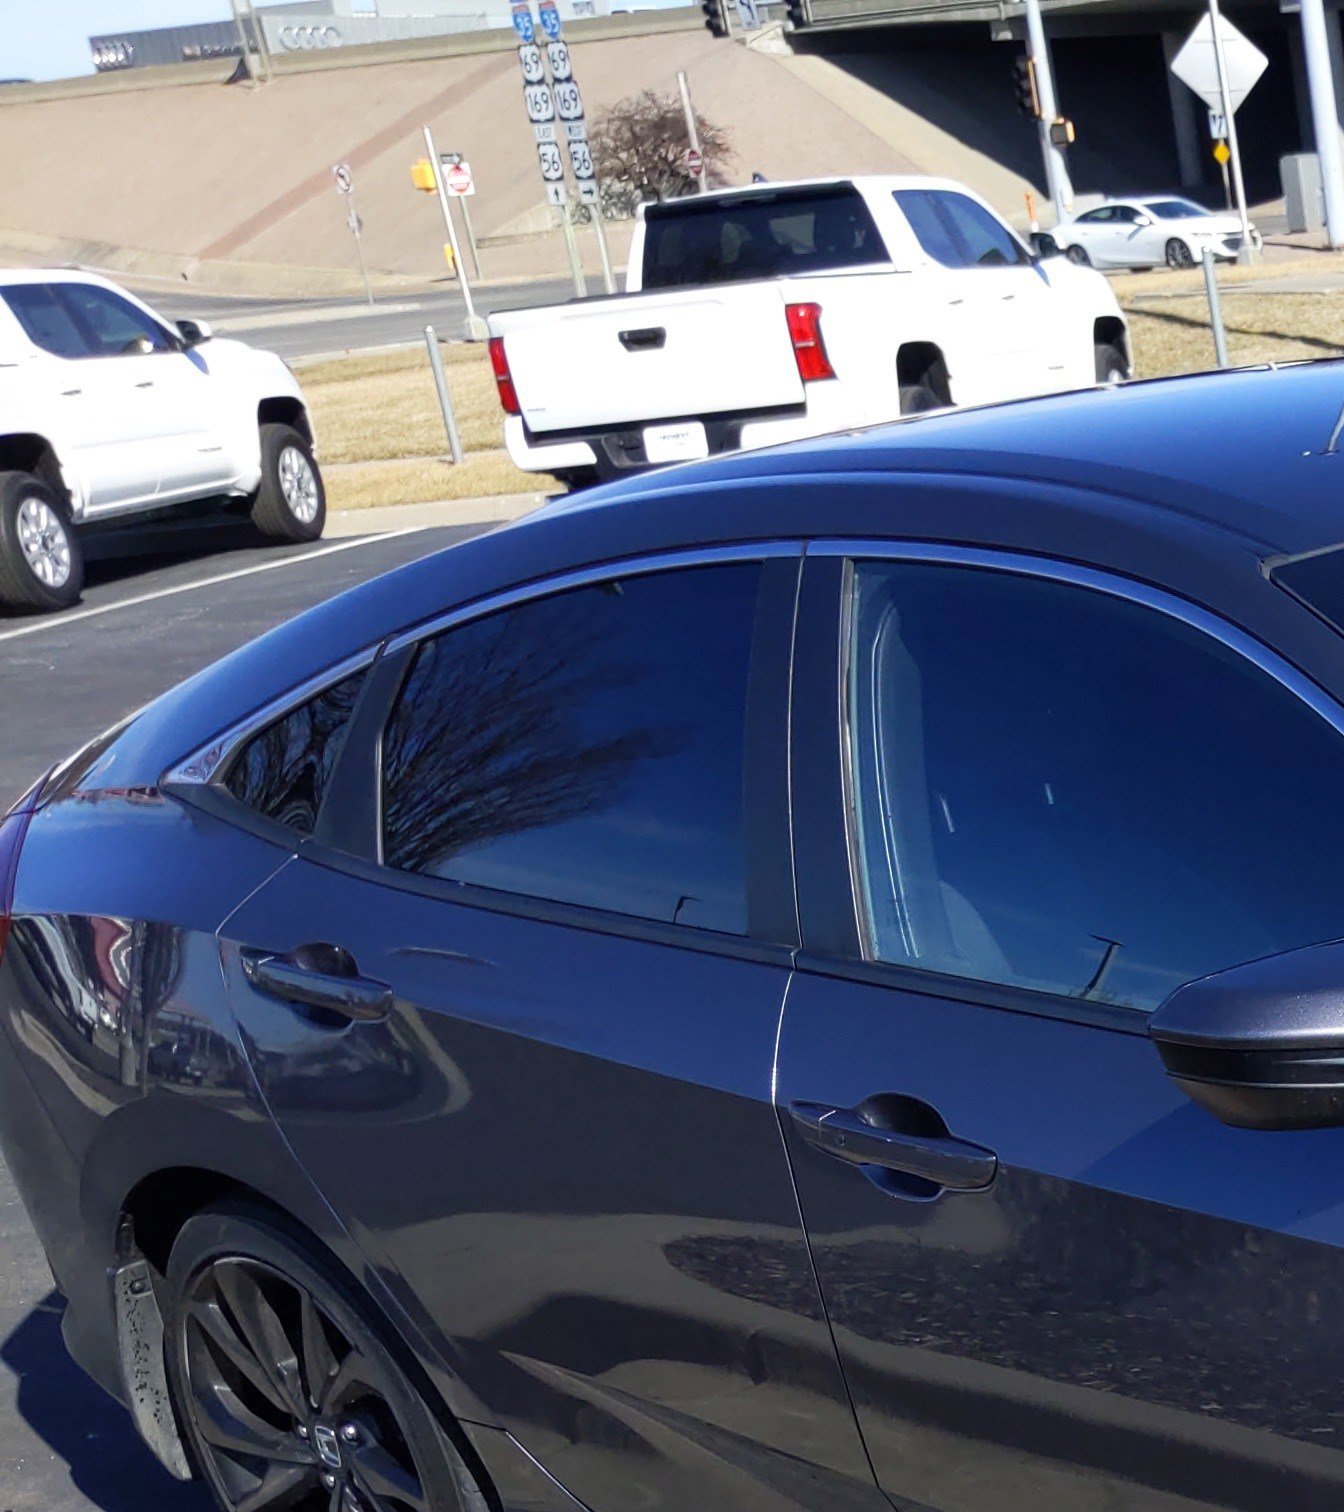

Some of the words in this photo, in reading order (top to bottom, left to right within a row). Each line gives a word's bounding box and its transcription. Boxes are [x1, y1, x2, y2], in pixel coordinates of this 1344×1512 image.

[524, 52, 539, 73] 69
[551, 49, 566, 71] 69
[528, 92, 549, 113] 169
[557, 89, 578, 110] 169
[541, 152, 560, 173] 56
[572, 150, 590, 171] 56
